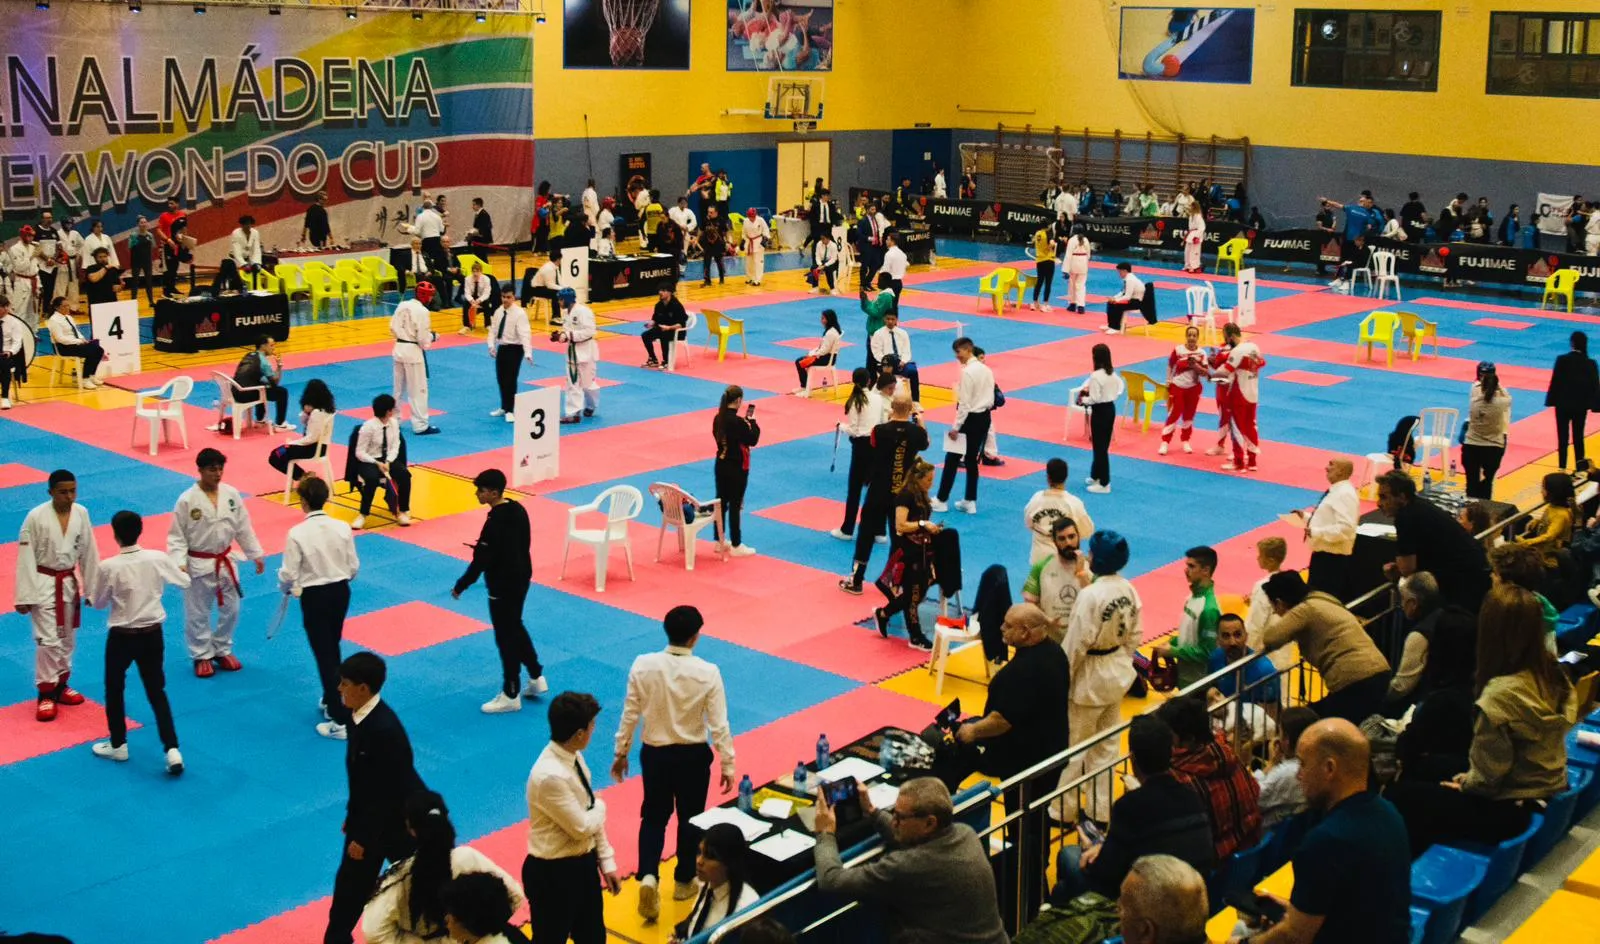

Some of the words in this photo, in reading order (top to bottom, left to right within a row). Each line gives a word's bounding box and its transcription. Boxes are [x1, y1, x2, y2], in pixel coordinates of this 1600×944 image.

[0, 43, 441, 127] NALMÁDENA
[340, 140, 439, 191] CUP
[934, 205, 972, 217] FUJIMAE
[1086, 223, 1131, 235] FUJIMAE
[1264, 239, 1311, 251] FUJIMAE
[570, 259, 580, 277] 6
[1459, 256, 1517, 271] FUJIMAE
[640, 268, 671, 279] FUJIMAE
[1243, 280, 1250, 300] 7
[108, 315, 124, 340] 4
[235, 313, 283, 327] FUJIMAE
[530, 408, 546, 440] 3
